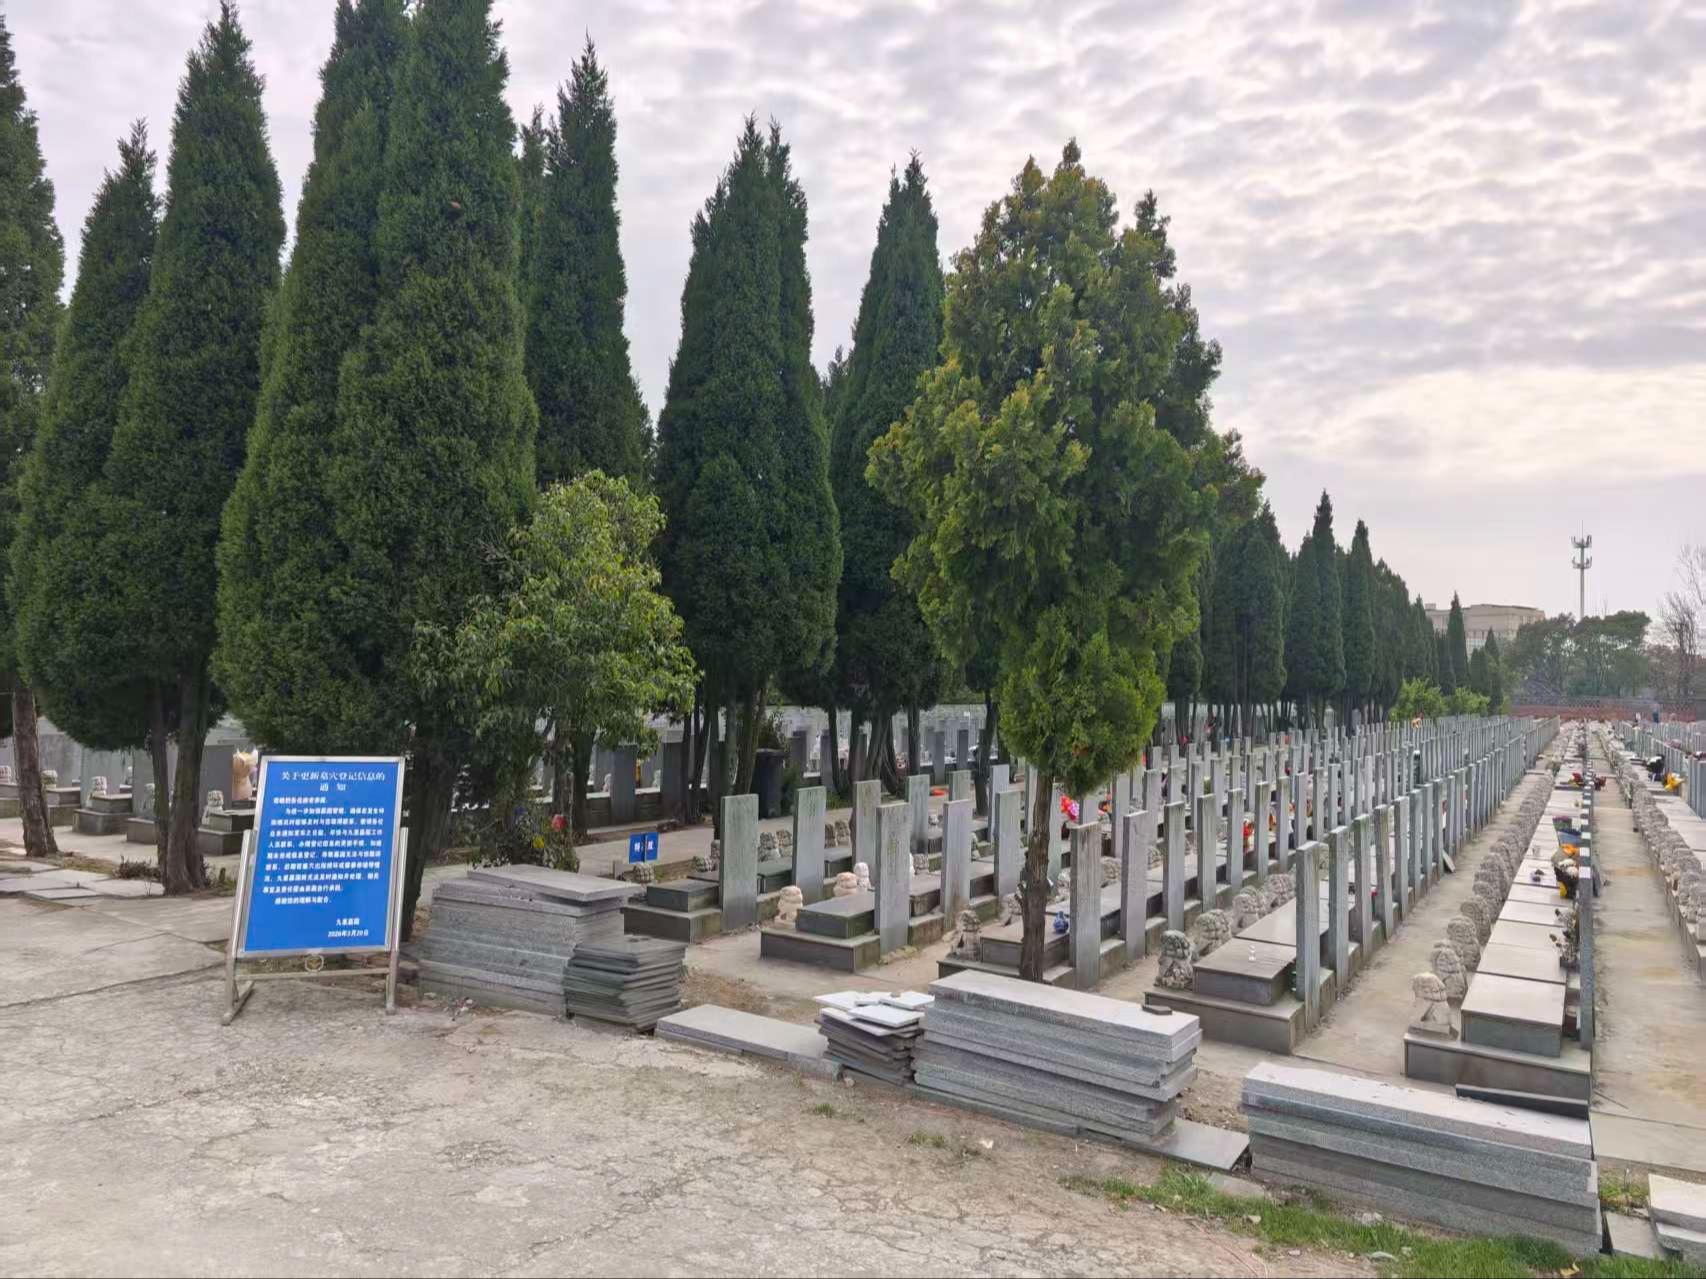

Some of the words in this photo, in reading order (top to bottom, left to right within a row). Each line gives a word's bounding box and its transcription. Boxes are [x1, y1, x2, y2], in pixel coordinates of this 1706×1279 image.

[282, 771, 385, 781] 关于更新墓穴登记信息的
